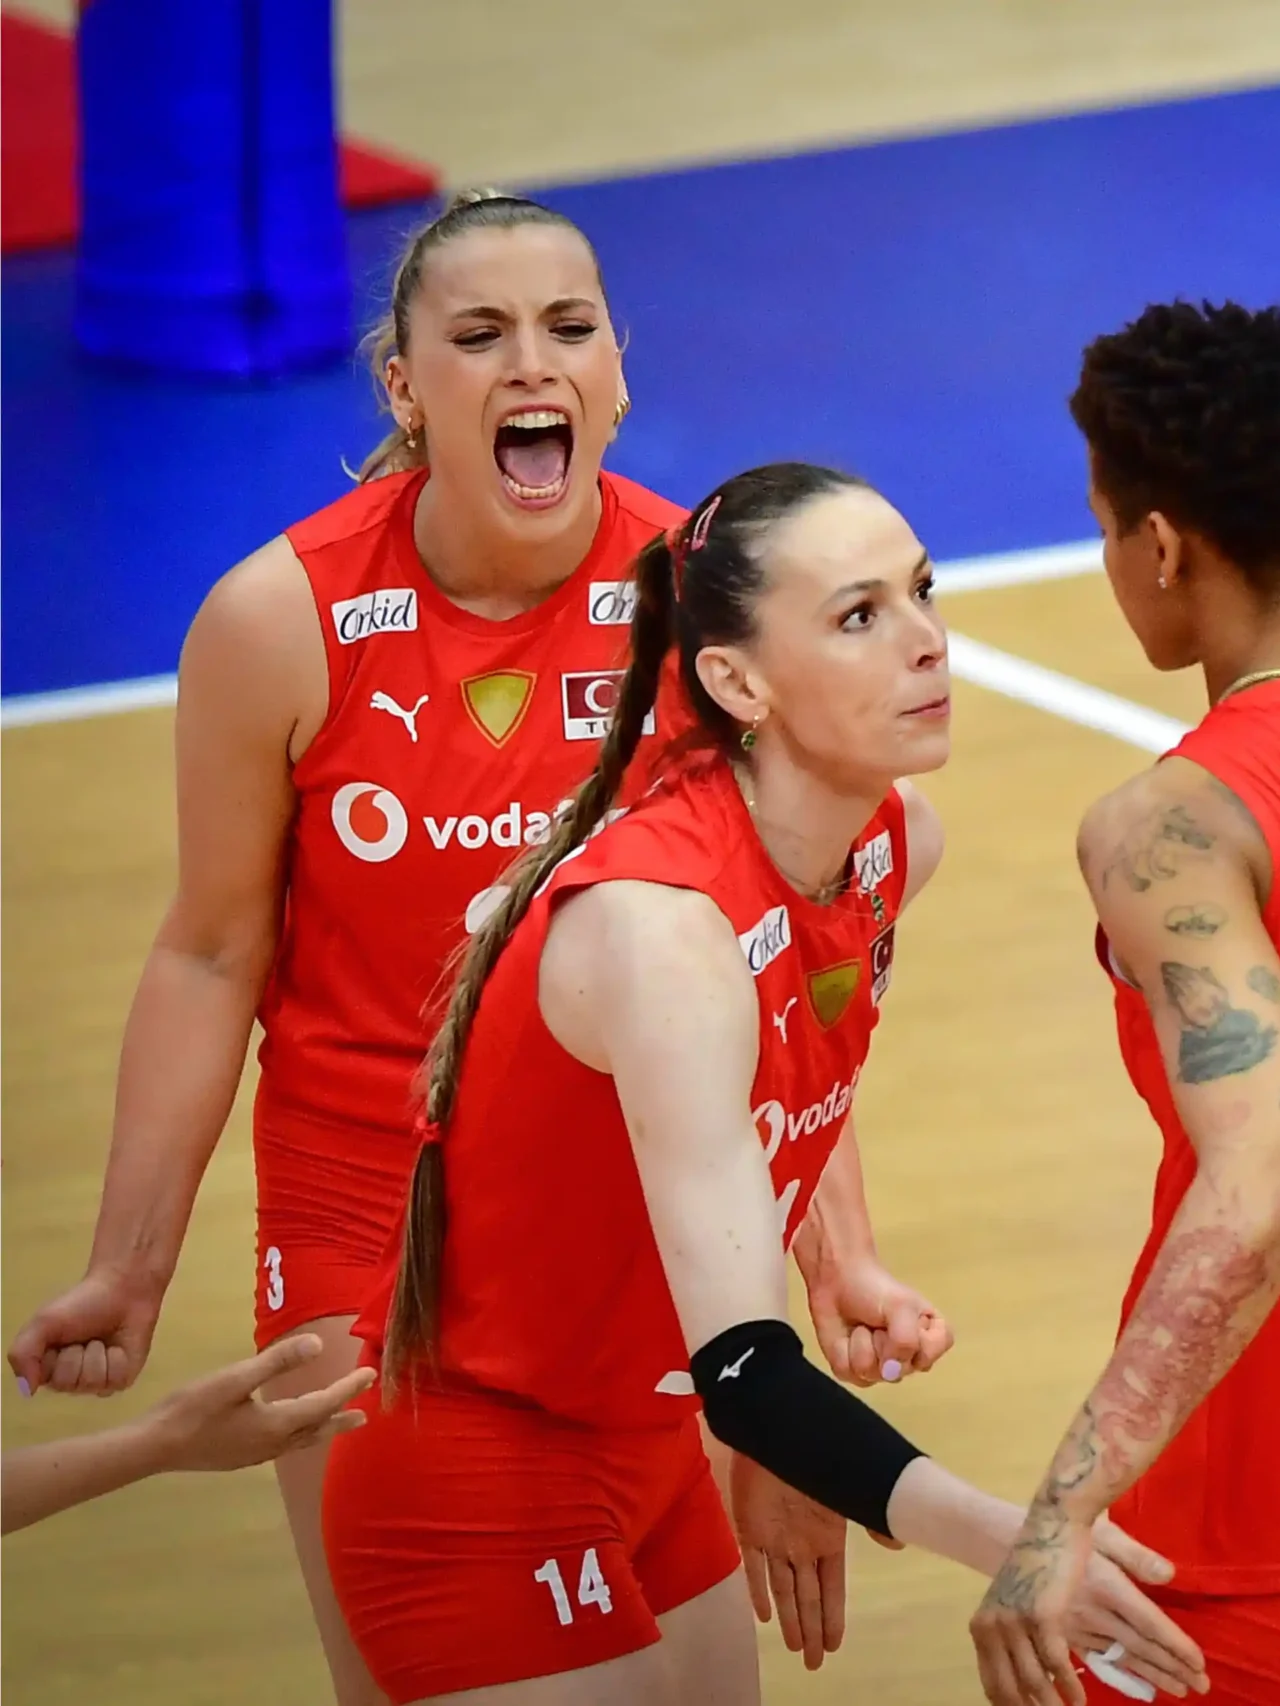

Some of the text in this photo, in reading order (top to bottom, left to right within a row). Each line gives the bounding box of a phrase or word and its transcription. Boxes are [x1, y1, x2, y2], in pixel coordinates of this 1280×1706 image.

[340, 592, 414, 641] Orkid
[264, 1246, 285, 1311] 3
[534, 1548, 613, 1626] 14
